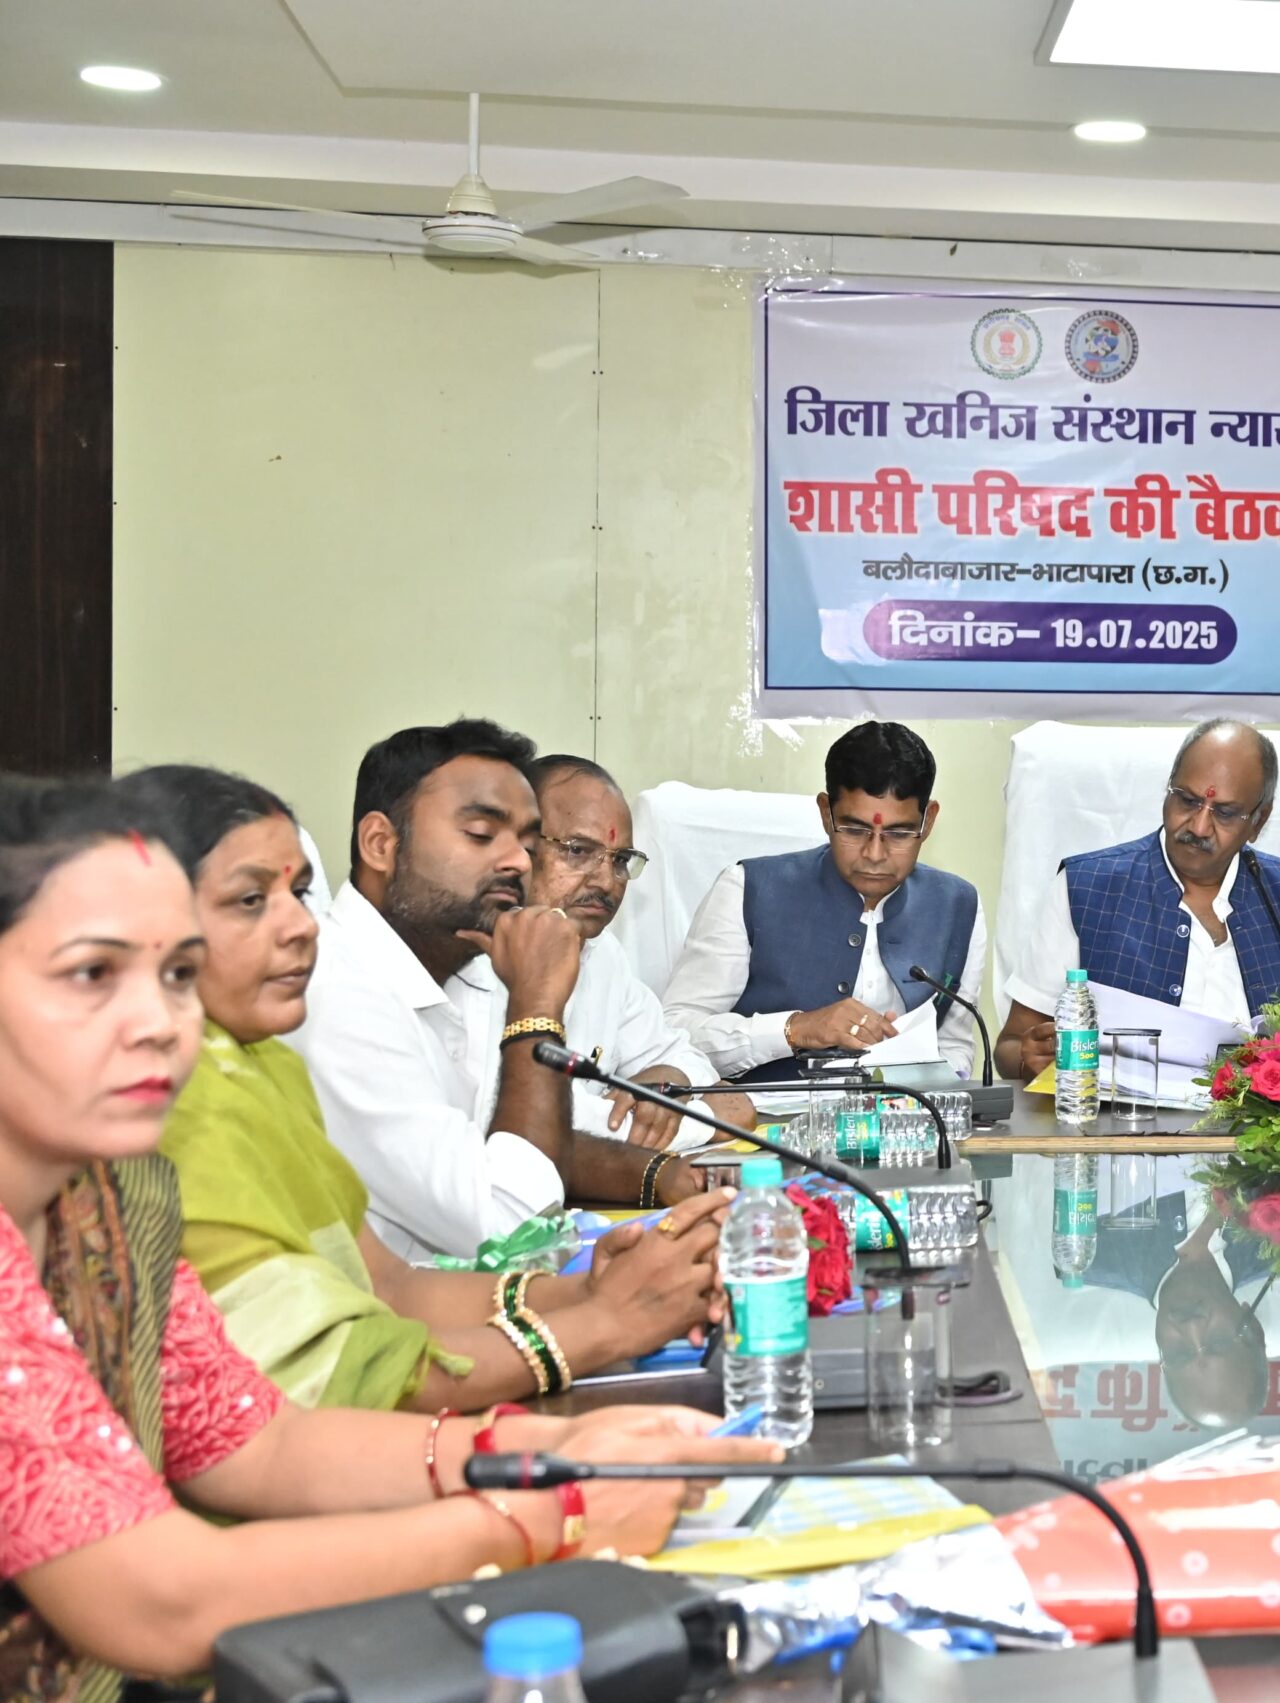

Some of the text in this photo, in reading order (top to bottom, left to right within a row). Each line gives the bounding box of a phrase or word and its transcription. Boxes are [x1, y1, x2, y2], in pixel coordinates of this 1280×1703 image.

[784, 385, 890, 437] जिला
[903, 390, 1039, 441] खनिज
[1050, 393, 1197, 445] संस्थान
[783, 467, 924, 534] शासी
[931, 469, 1095, 538] परिषद
[1103, 473, 1182, 540] की
[861, 552, 1230, 593] बलौदाबाजार-भाटापारा (छ.ग.)
[1050, 618, 1219, 650] 19.07.2025
